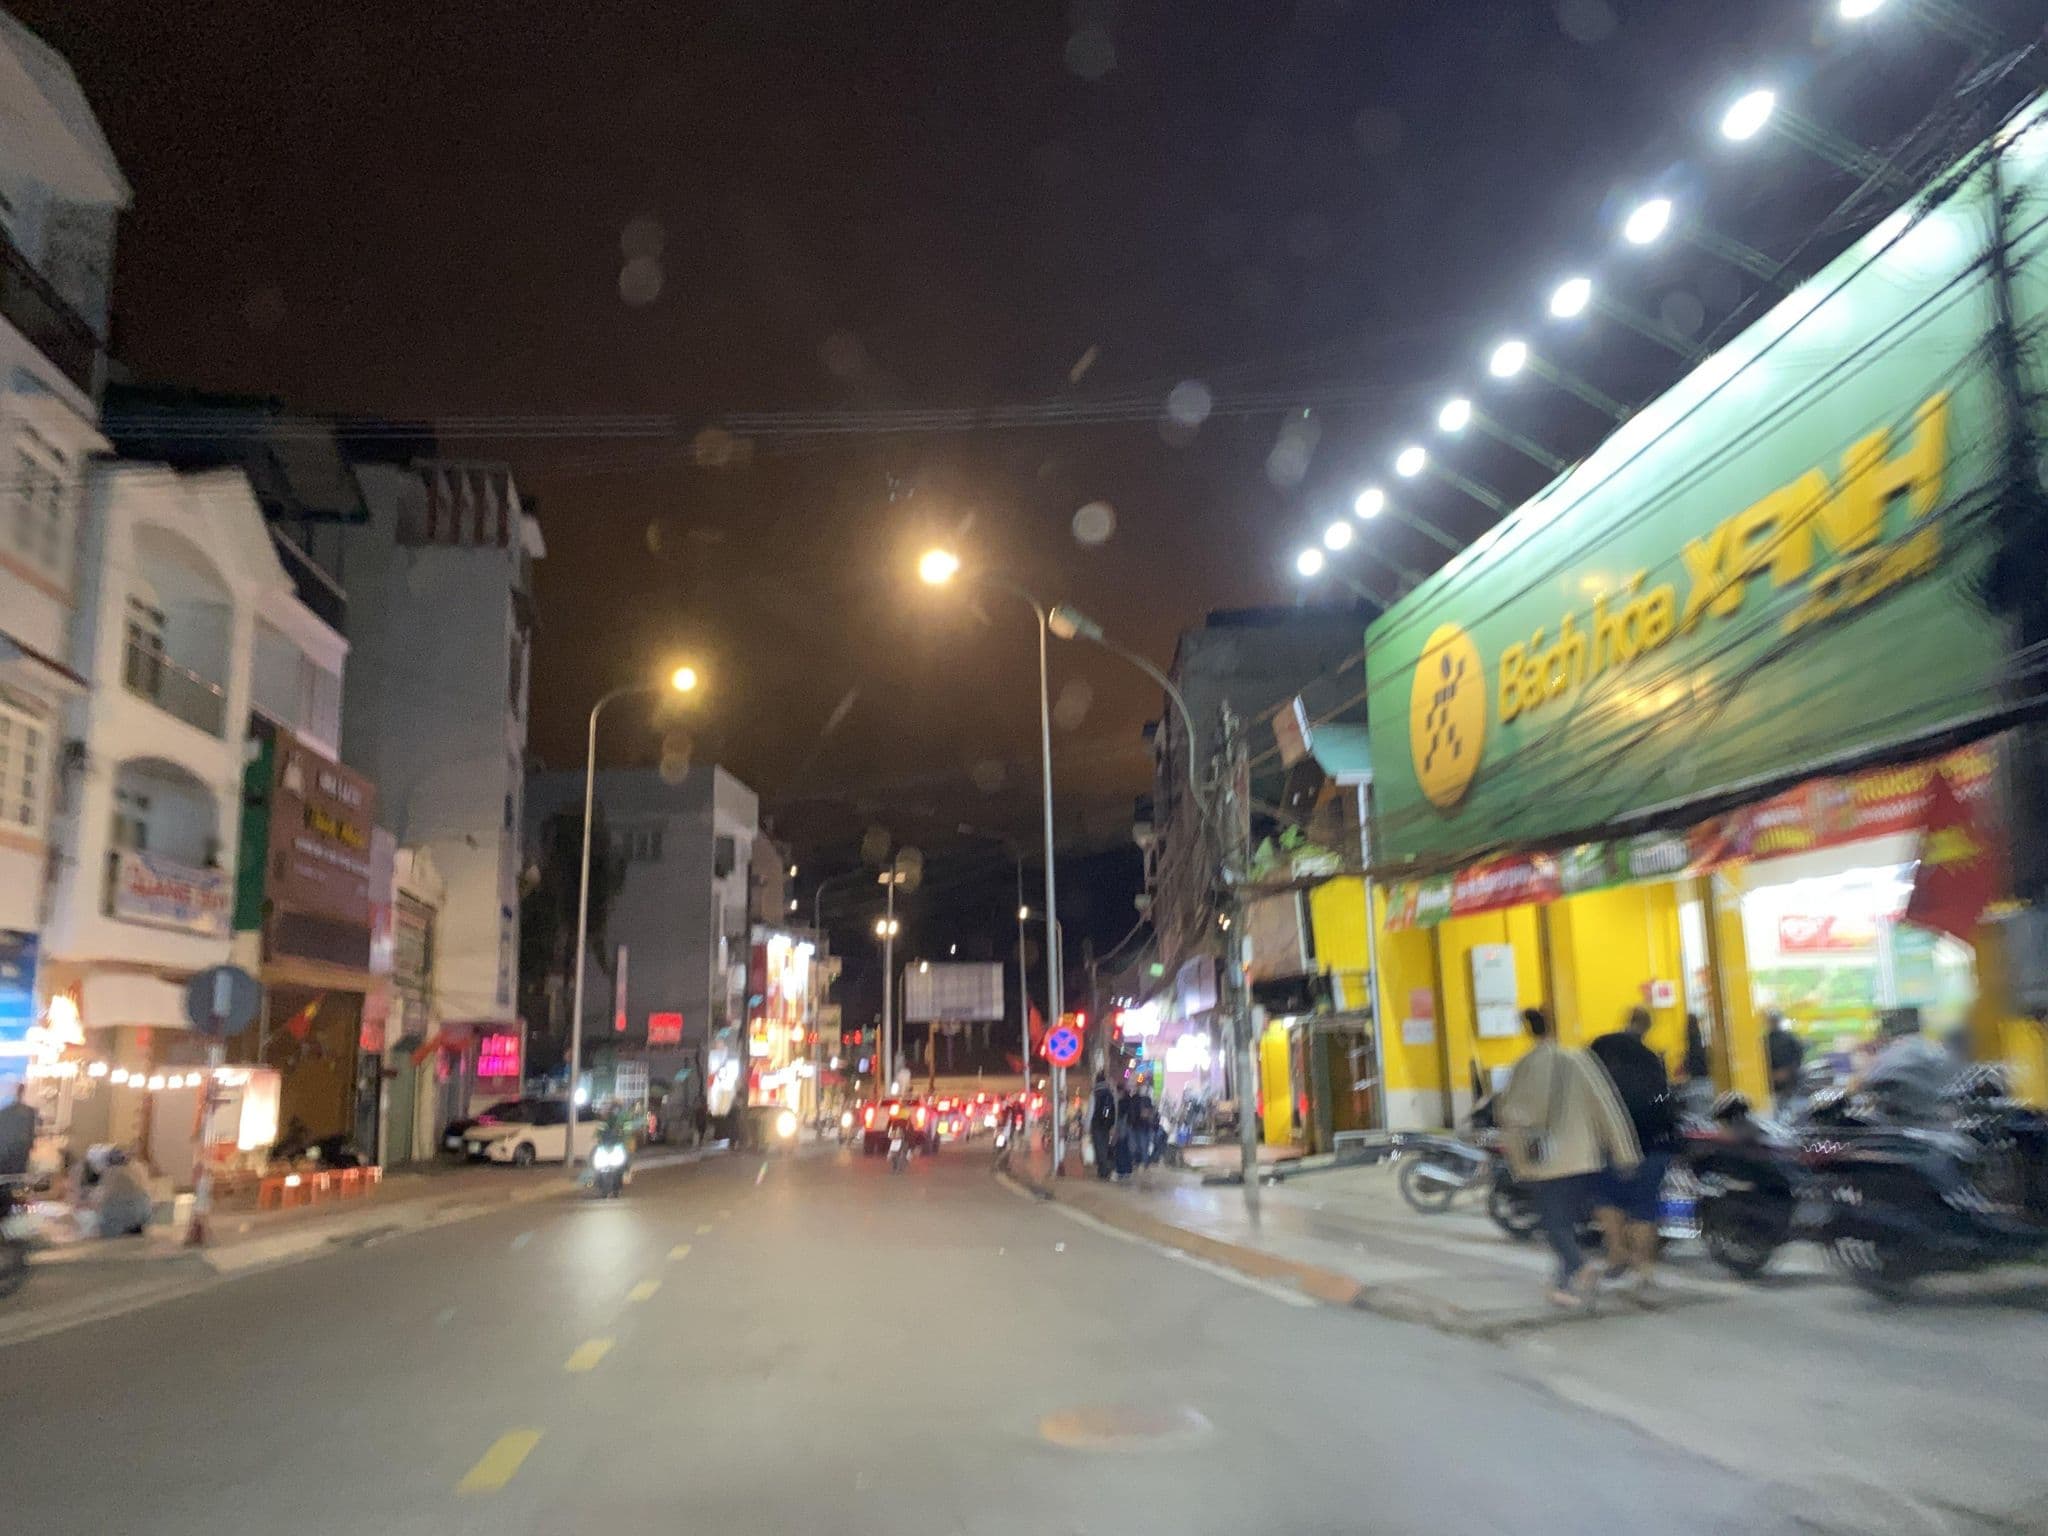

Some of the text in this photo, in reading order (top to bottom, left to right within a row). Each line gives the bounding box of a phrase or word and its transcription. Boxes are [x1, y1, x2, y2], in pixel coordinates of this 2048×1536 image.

[1499, 625, 1585, 723] Bách
[1593, 567, 1675, 673] hóa
[1679, 389, 1949, 635] XANH
